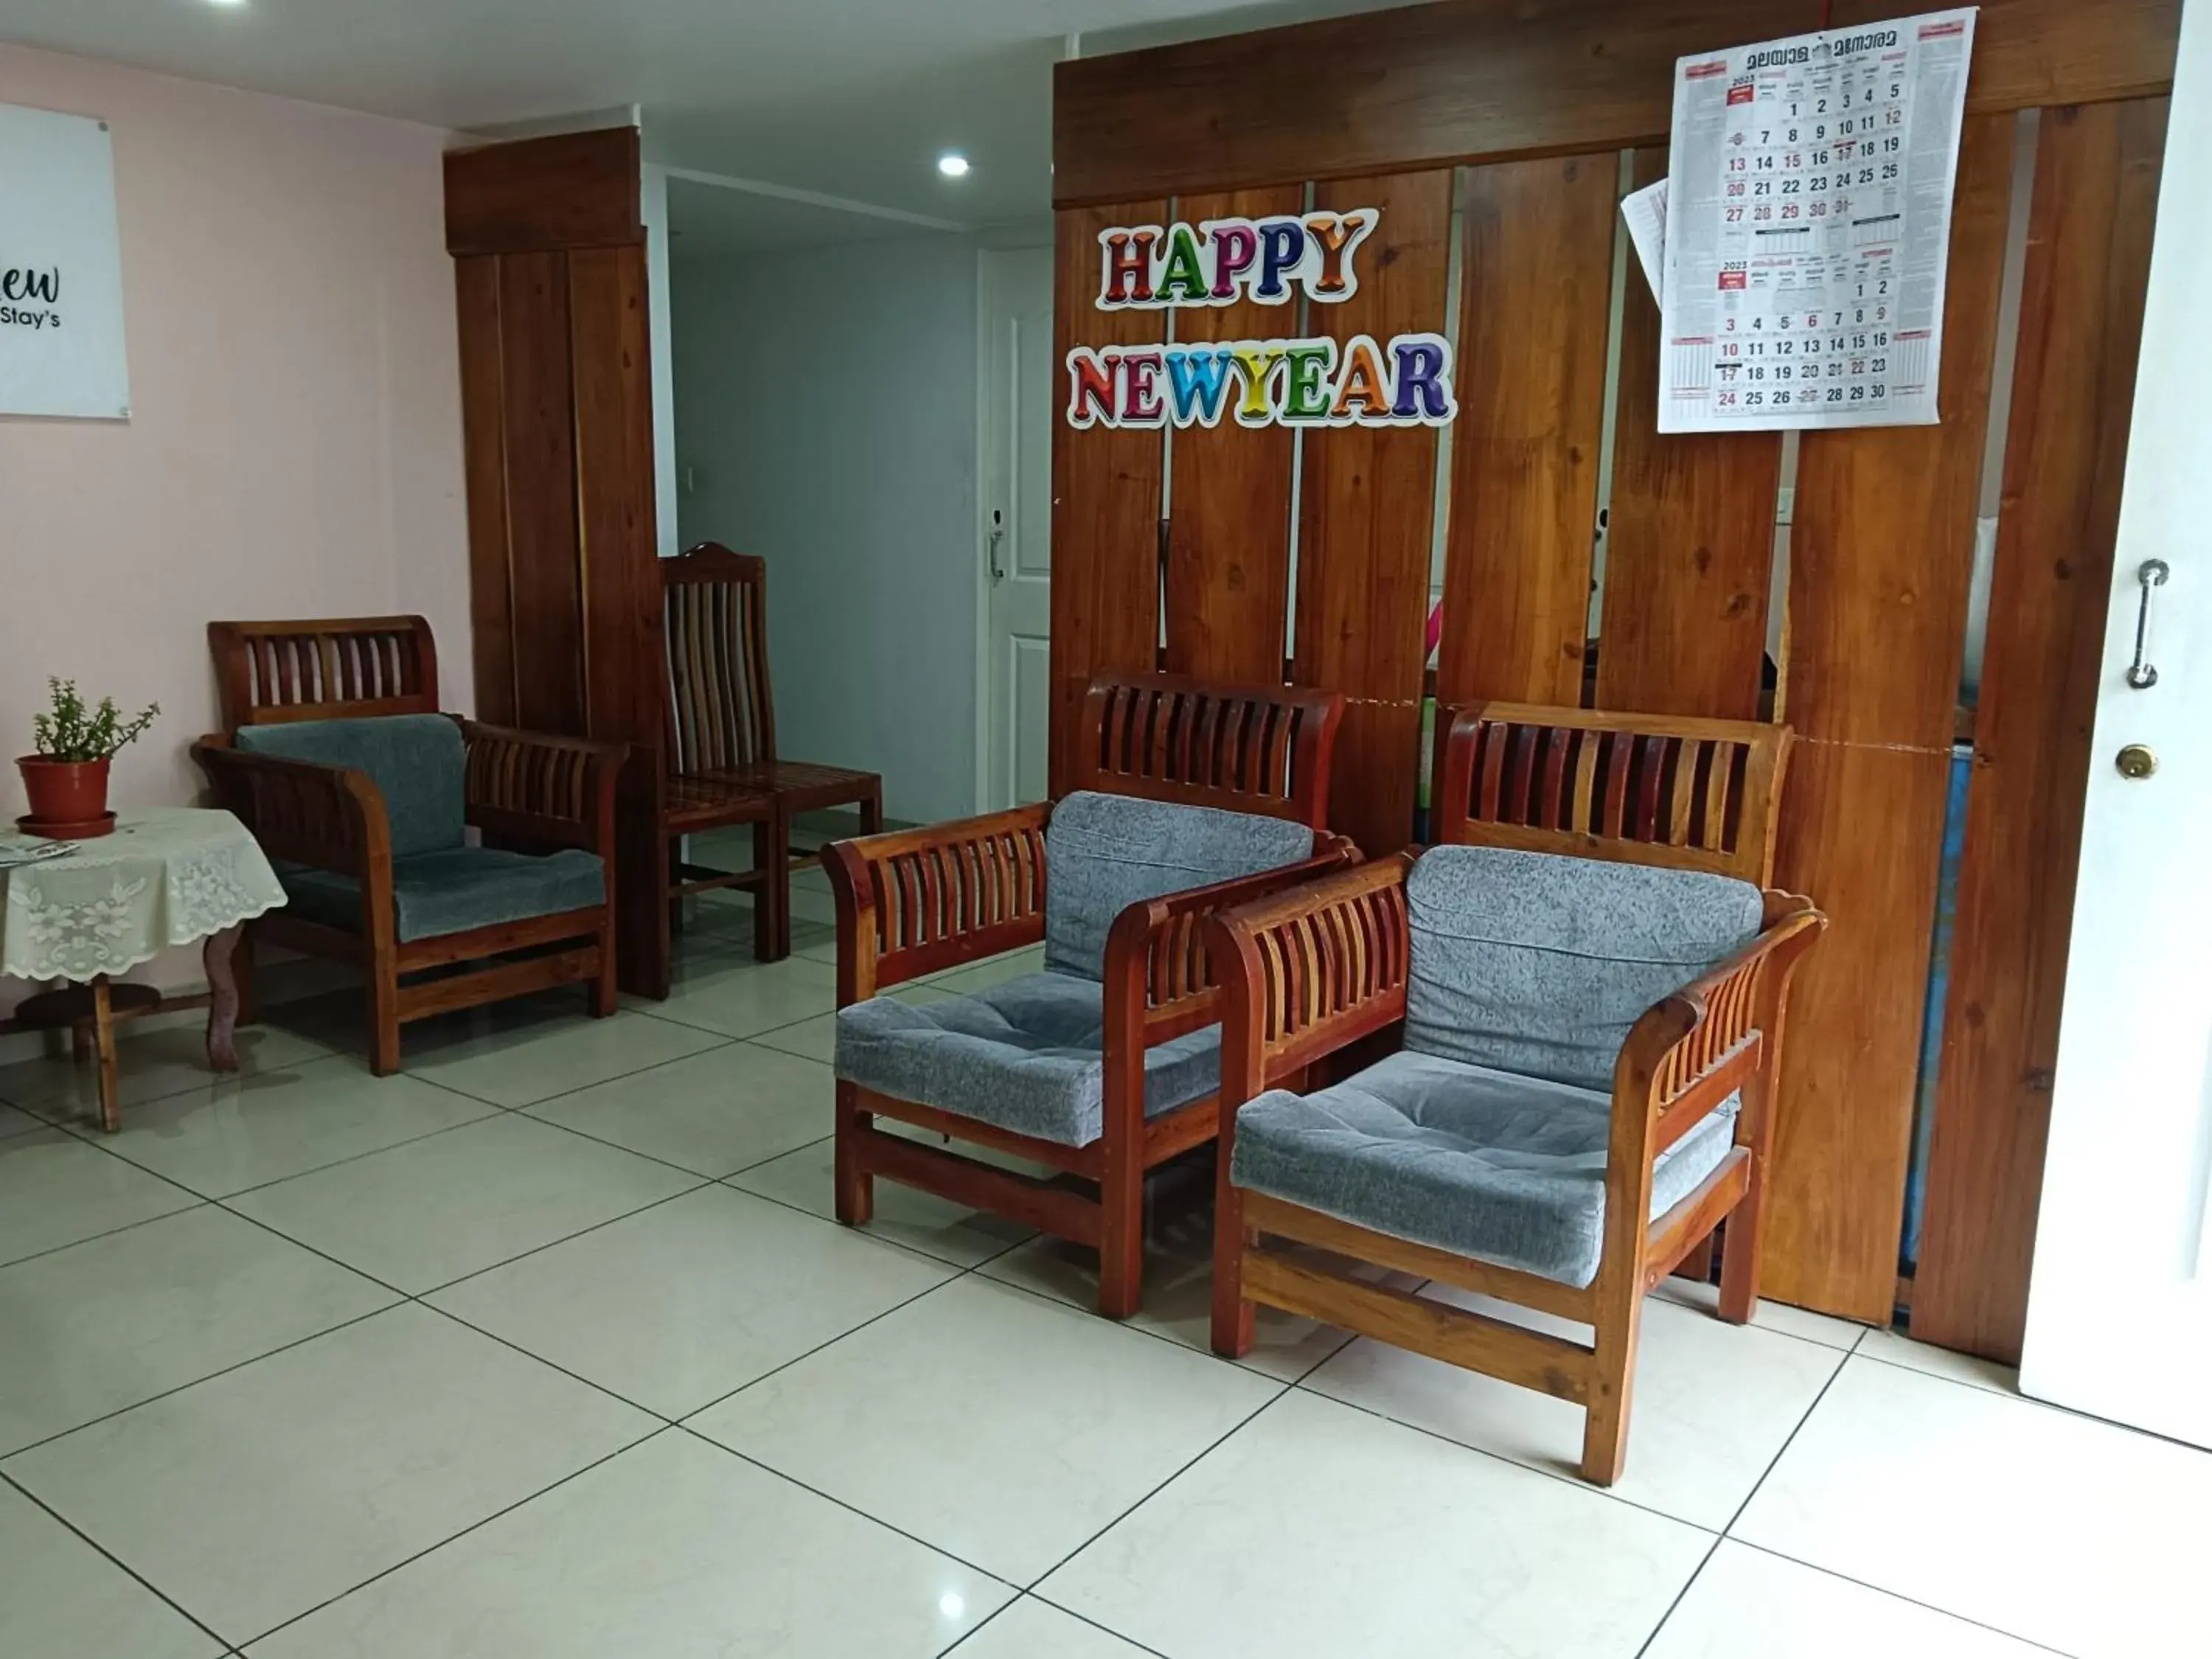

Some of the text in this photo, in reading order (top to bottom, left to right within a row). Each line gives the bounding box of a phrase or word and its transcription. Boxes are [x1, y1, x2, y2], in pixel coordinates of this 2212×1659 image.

[1733, 74, 1755, 86] 2023
[1791, 84, 1899, 116] 1 2 3 4 5
[1761, 131, 1770, 143] 7
[1789, 129, 1797, 142] 8
[1817, 125, 1825, 139] 9
[1840, 120, 1852, 134] 10
[1861, 116, 1874, 130] 11
[1885, 111, 1901, 125] 12
[1730, 158, 1745, 171] 13
[1756, 156, 1773, 170] 14
[1784, 155, 1801, 167] 15
[1812, 151, 1828, 164] 16
[1860, 142, 1874, 156] 18
[1884, 137, 1899, 152] 19
[1727, 164, 1898, 196] 20 21 22 23 24 25 26
[1727, 209, 1743, 222] 27
[1781, 206, 1798, 219] 29
[1809, 203, 1826, 217] 30
[1105, 215, 1366, 303] HAPPY
[1724, 261, 1747, 270] 2023
[0, 266, 60, 303] ew
[1858, 281, 1887, 296] 1 2
[1, 306, 60, 330] Stay's
[1726, 319, 1735, 331] 3
[1753, 318, 1761, 330] 4
[1781, 316, 1790, 329] 5
[1809, 315, 1817, 327] 6
[1835, 313, 1842, 324] 7
[1856, 309, 1863, 322] 8
[1722, 344, 1738, 356] 10
[1749, 343, 1763, 355] 11
[1777, 341, 1792, 354] 12
[1804, 340, 1820, 352] 13
[1830, 338, 1843, 351] 14
[1853, 335, 1865, 348] 15
[1874, 333, 1886, 346] 16
[1722, 369, 1737, 380] 17
[1748, 367, 1764, 380] 18
[1775, 366, 1791, 379] 19
[1852, 361, 1864, 375] 22
[1872, 358, 1885, 372] 23
[1072, 342, 1451, 422] NEWYEAR
[1719, 394, 1735, 406] 24
[1746, 392, 1762, 405] 25
[1773, 391, 1790, 404] 26
[1827, 388, 1842, 401] 28
[1850, 386, 1863, 400] 29
[1871, 385, 1885, 398] 30
